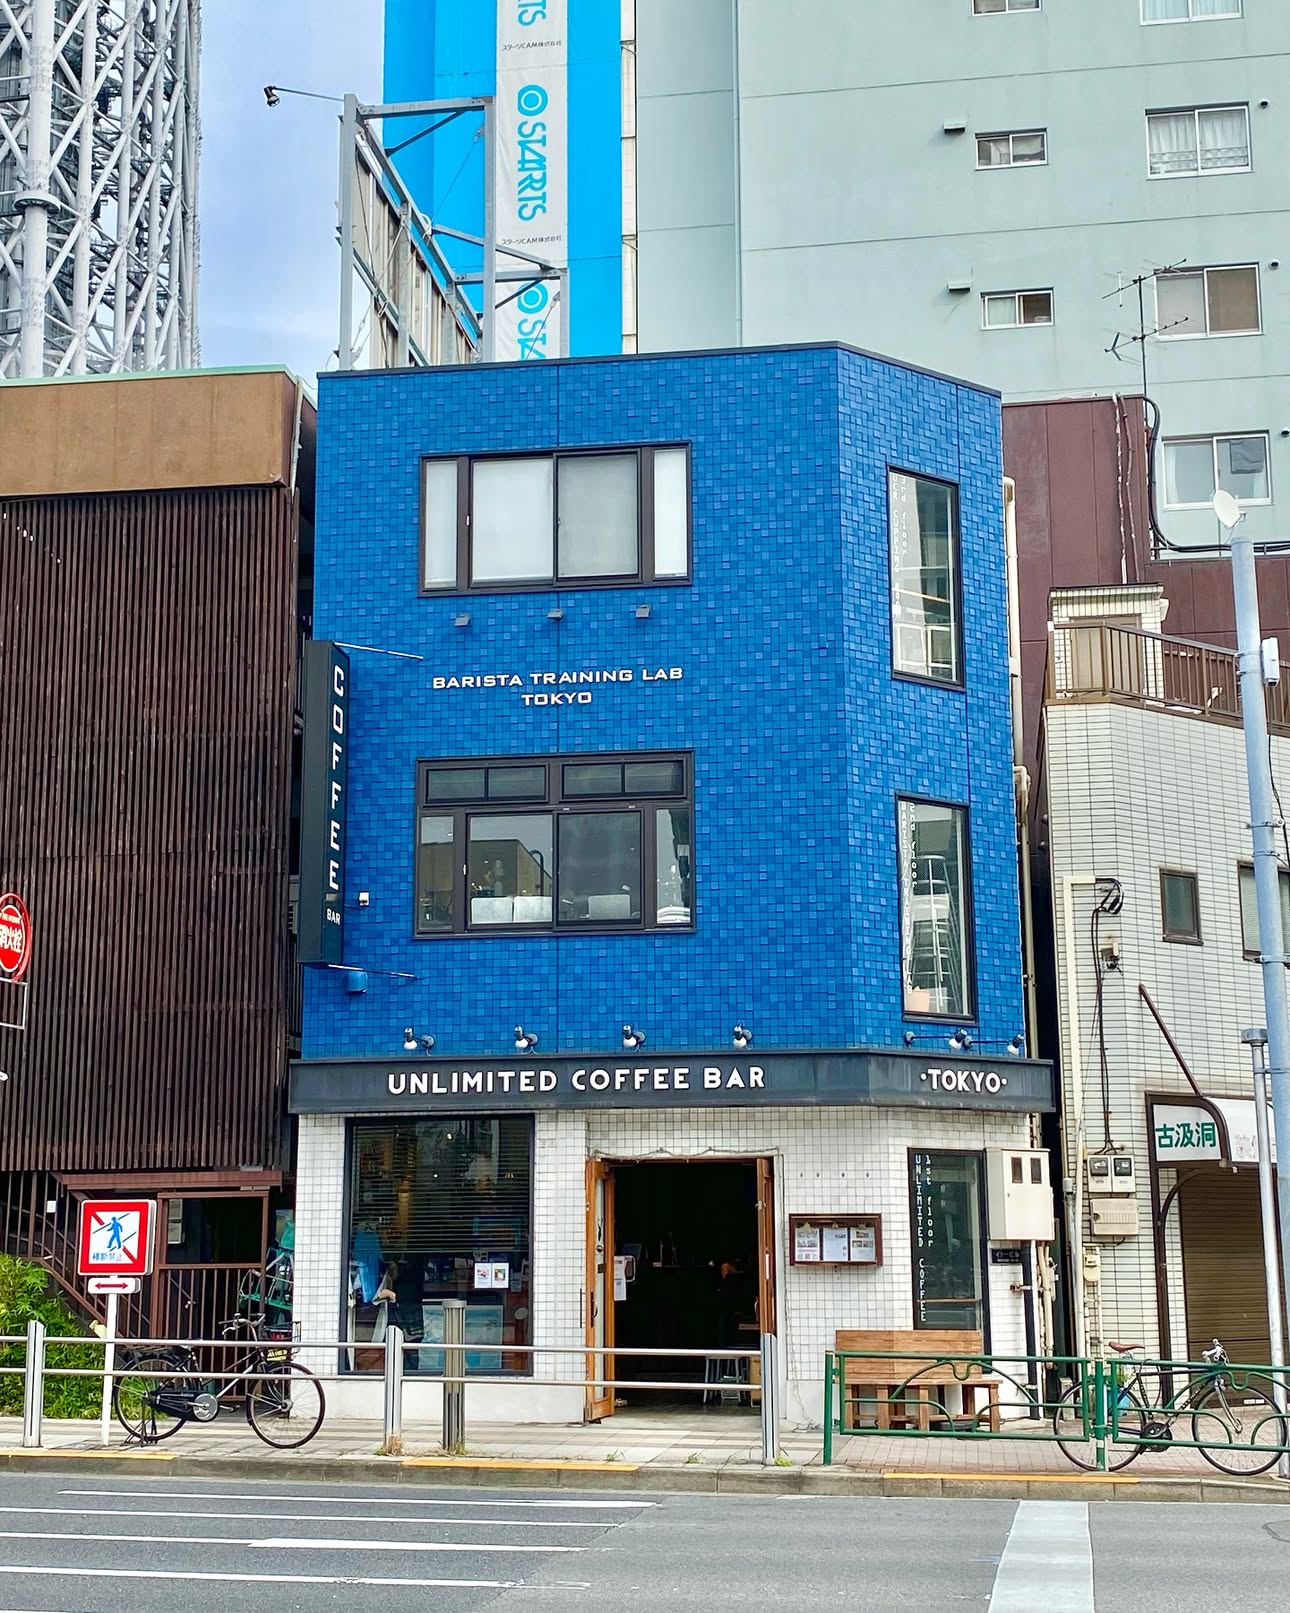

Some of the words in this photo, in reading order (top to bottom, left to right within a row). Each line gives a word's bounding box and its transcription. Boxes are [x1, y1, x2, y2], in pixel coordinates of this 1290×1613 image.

[517, 120, 547, 222] STARTS
[433, 673, 522, 689] BARISTA
[530, 669, 633, 685] TRAINING
[642, 667, 683, 681] LAB
[521, 691, 592, 707] TOKYO
[329, 664, 345, 891] COFFEE
[326, 908, 341, 926] BAR
[388, 1070, 557, 1095] UNLIMITED
[571, 1067, 690, 1092] COFFEE
[703, 1066, 765, 1089] BAR
[1156, 1121, 1217, 1148] 古汲洞
[915, 1154, 924, 1248] UNLIMITED
[918, 1258, 926, 1322] COFFEE
